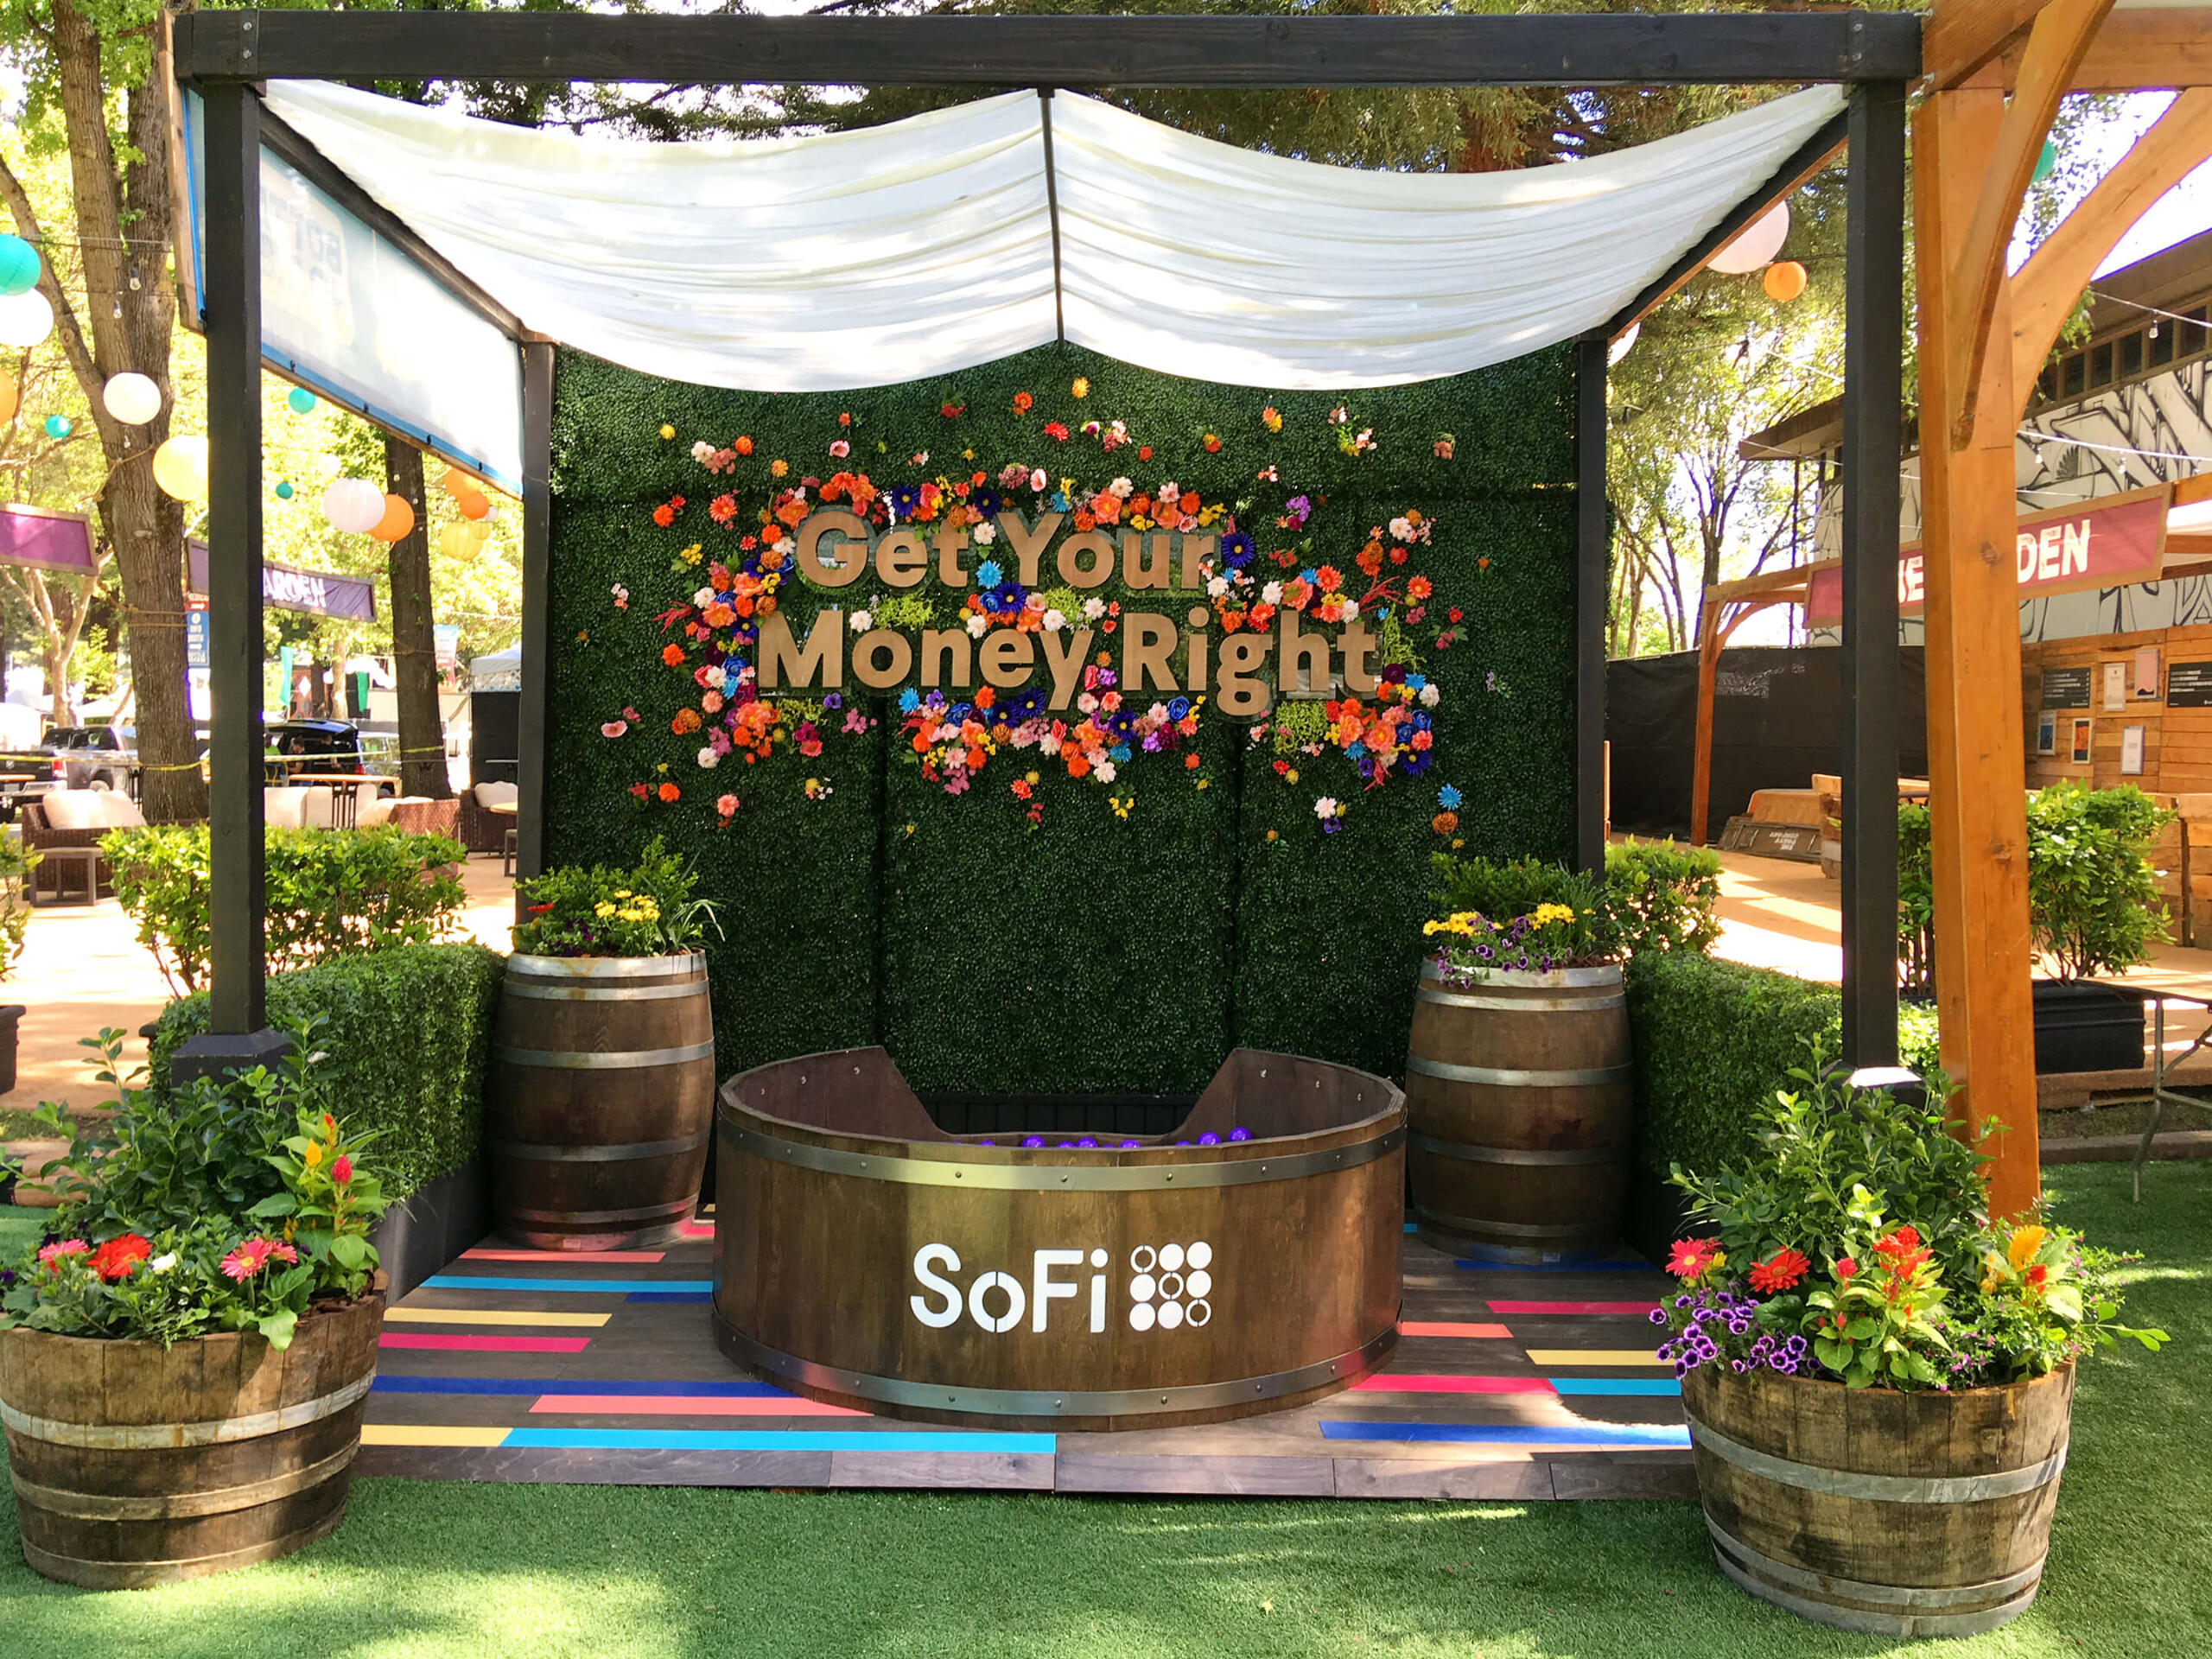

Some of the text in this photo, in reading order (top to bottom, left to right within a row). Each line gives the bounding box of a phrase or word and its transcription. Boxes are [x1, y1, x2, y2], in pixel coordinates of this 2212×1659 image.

[797, 512, 1215, 589] Get Your
[2017, 518, 2091, 584] DEN
[758, 607, 1377, 716] Money Right
[910, 1243, 1109, 1333] SoFi
